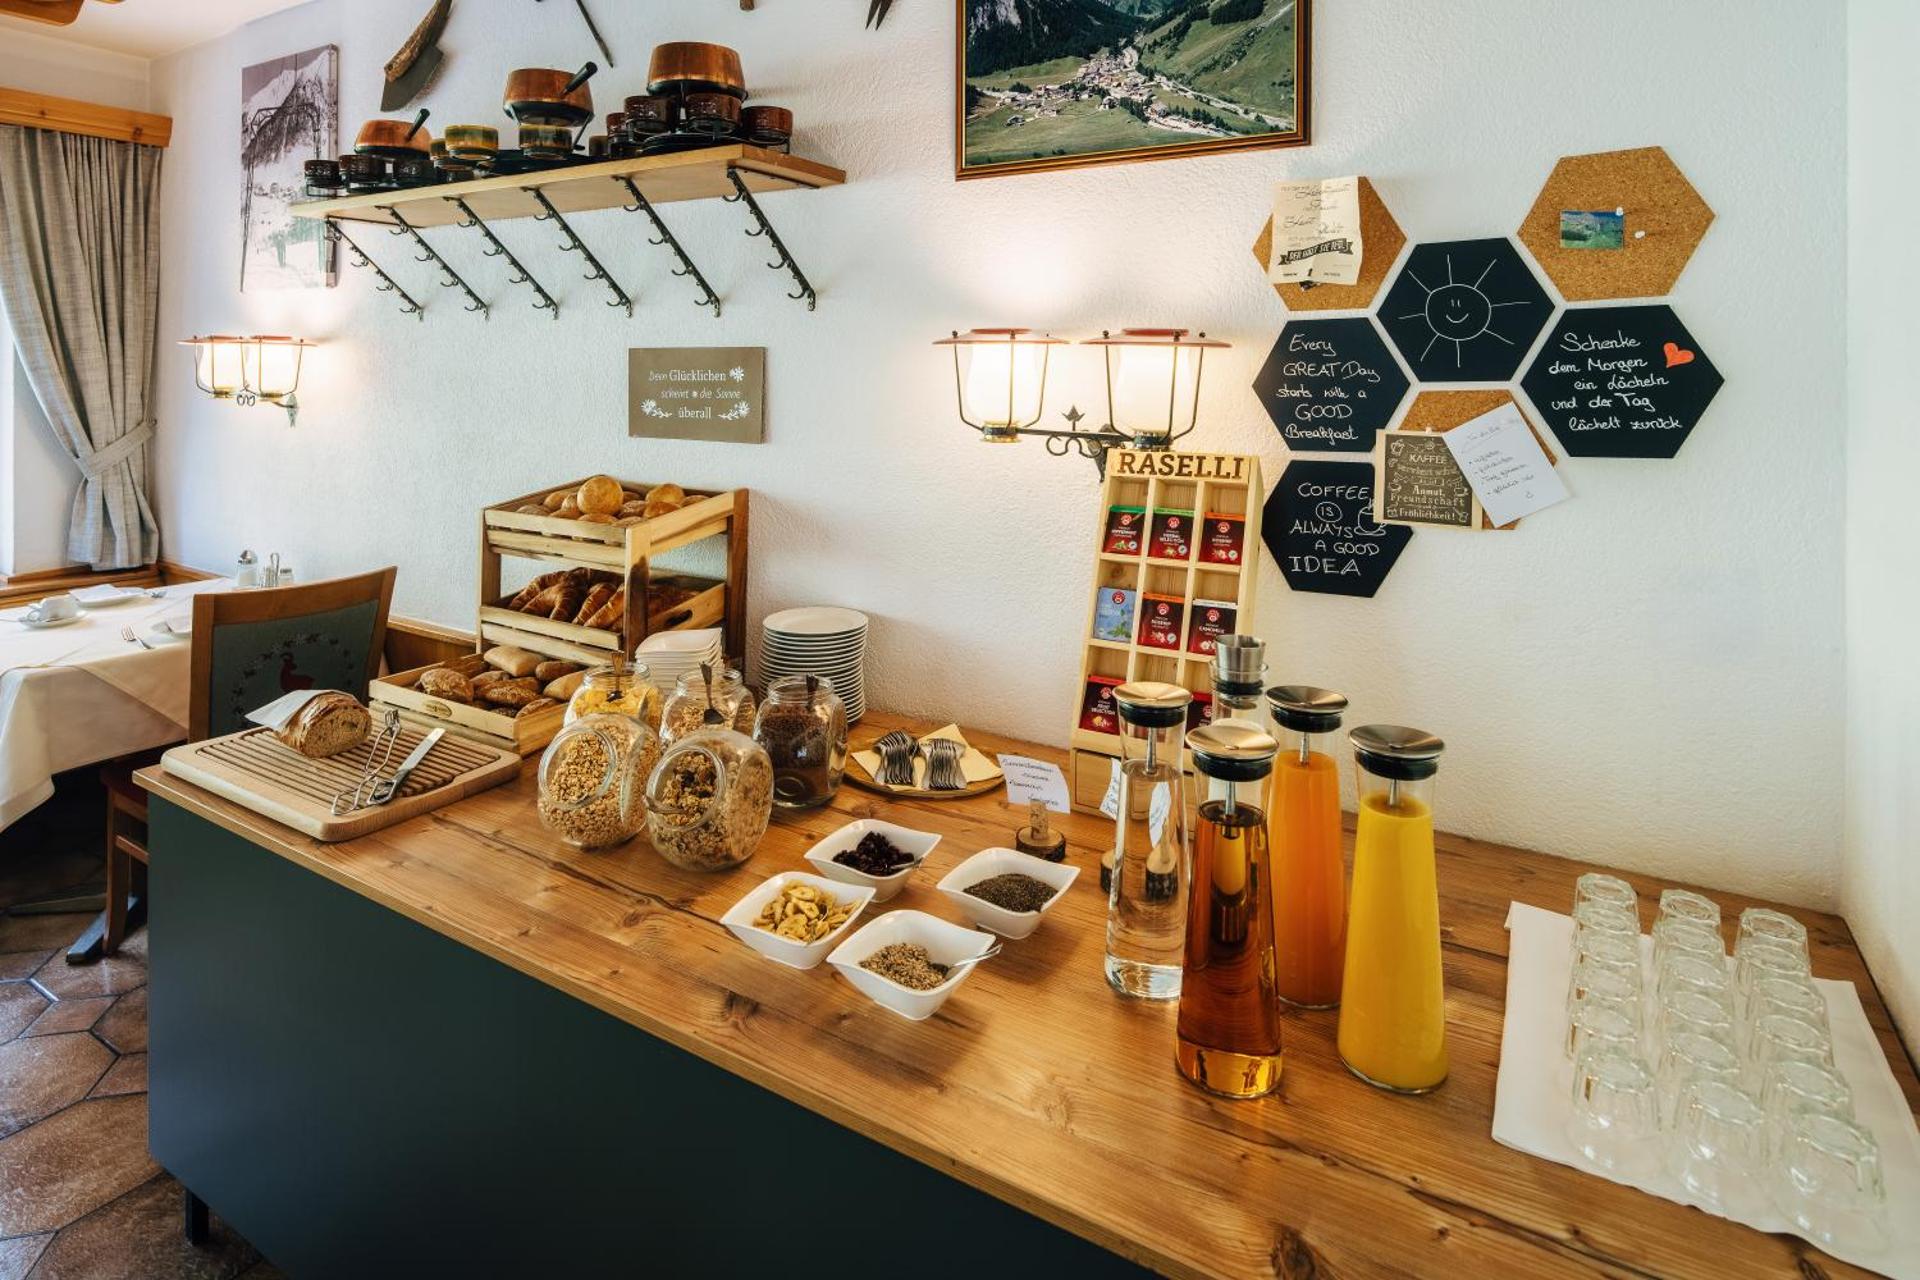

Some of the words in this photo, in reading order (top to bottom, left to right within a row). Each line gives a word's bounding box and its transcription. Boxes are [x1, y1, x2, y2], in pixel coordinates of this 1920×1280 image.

[1289, 334, 1337, 356] Every
[1560, 330, 1641, 351] Schenke
[1283, 361, 1340, 377] GREAT
[1341, 360, 1381, 382] Day
[1548, 361, 1581, 374] dem
[1588, 358, 1648, 373] Morgen
[669, 369, 726, 381] Glücklichen
[1574, 379, 1597, 390] ein
[1607, 374, 1670, 389] Lächeln
[1276, 384, 1312, 398] starts
[1324, 386, 1349, 399] with
[1358, 390, 1367, 398] a
[1551, 397, 1577, 410] und
[1588, 395, 1613, 408] der
[1614, 392, 1656, 412] Tag
[678, 406, 712, 419] überall
[1295, 404, 1352, 421] GOOD
[1569, 417, 1621, 431] lächelt
[1630, 416, 1683, 430] zurück
[1285, 423, 1358, 445] Breakfast
[1117, 452, 1245, 480] RASELLI
[1297, 482, 1370, 499] COFFEE
[1320, 506, 1334, 517] IS
[1289, 520, 1354, 538] ALWAYS
[1315, 540, 1327, 552] A
[1333, 543, 1379, 556] GOOD
[1288, 555, 1361, 576] IDEA
